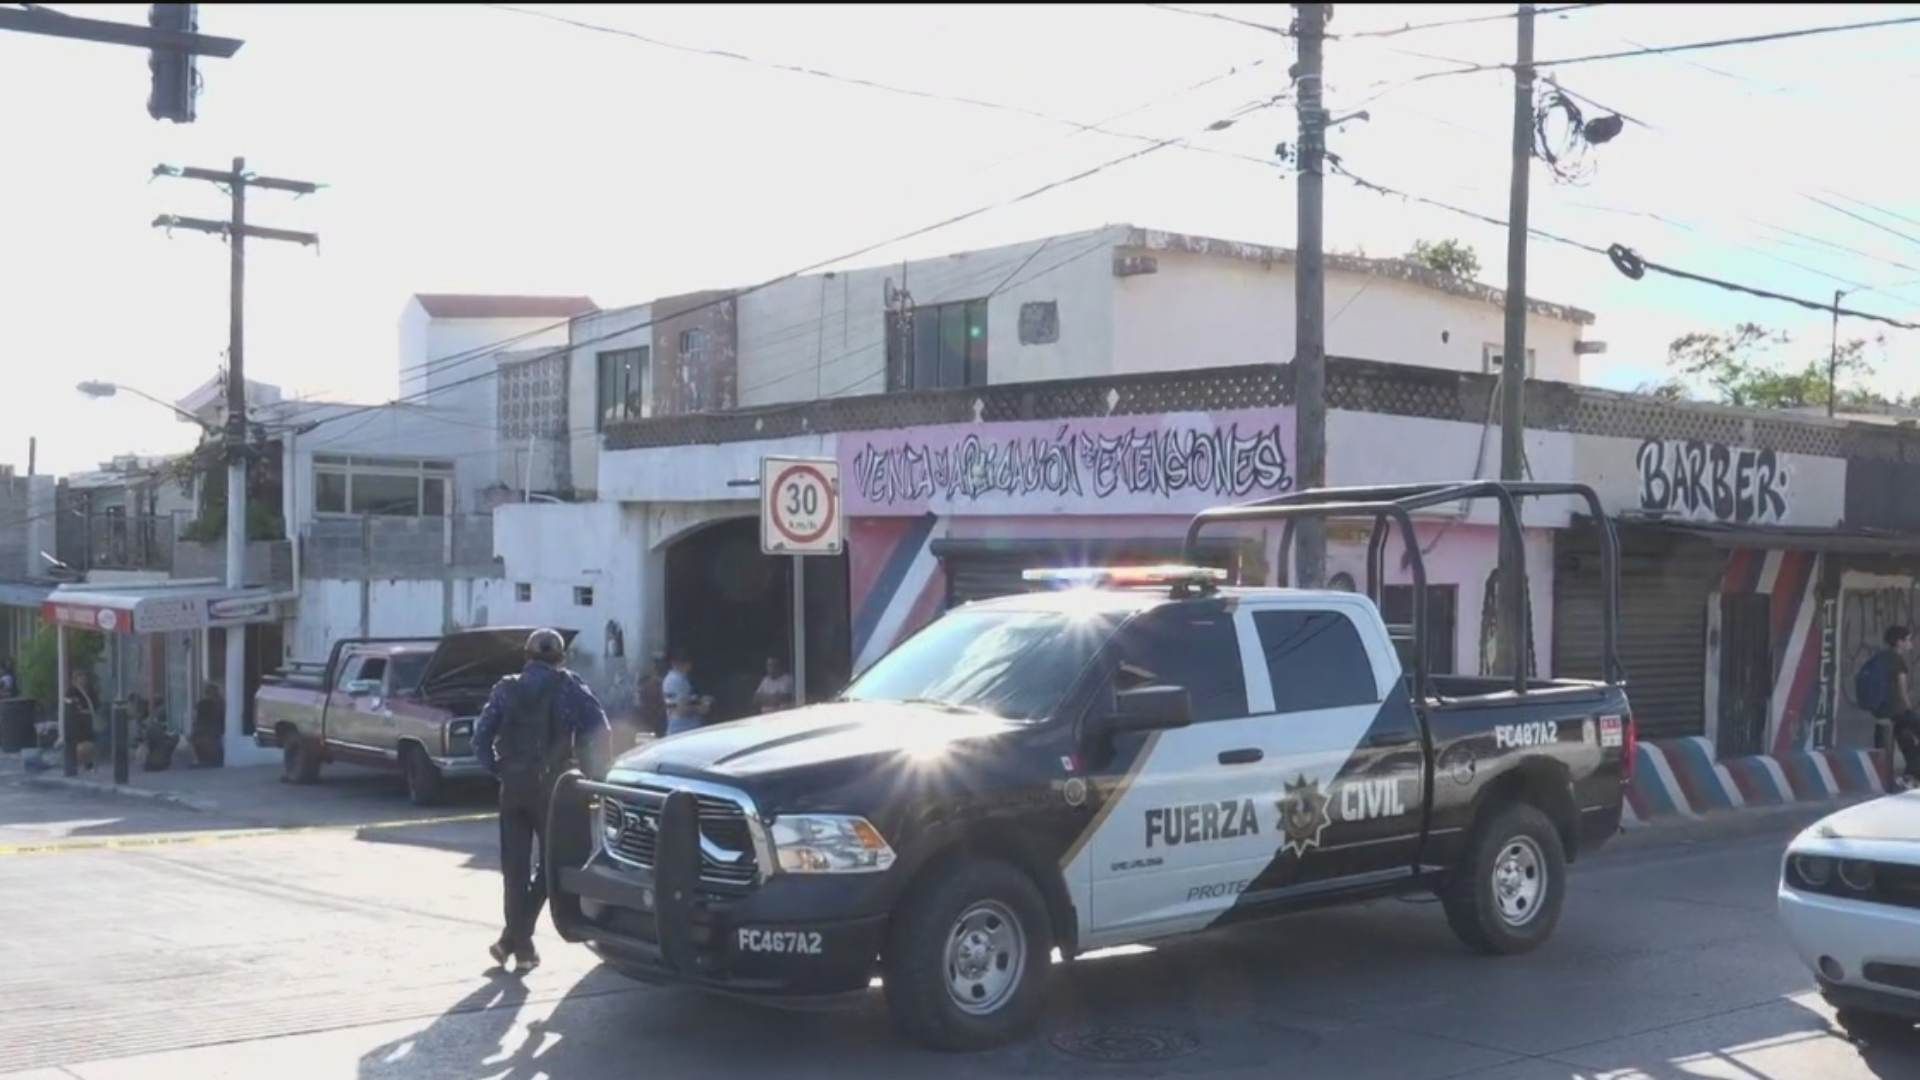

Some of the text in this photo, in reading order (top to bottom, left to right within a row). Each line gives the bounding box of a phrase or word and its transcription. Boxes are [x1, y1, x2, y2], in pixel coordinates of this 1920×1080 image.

[853, 442, 936, 505] VENTA
[786, 483, 818, 515] 30
[1145, 778, 1404, 848] FUERZA CIVIL
[738, 927, 823, 954] FC467A2
